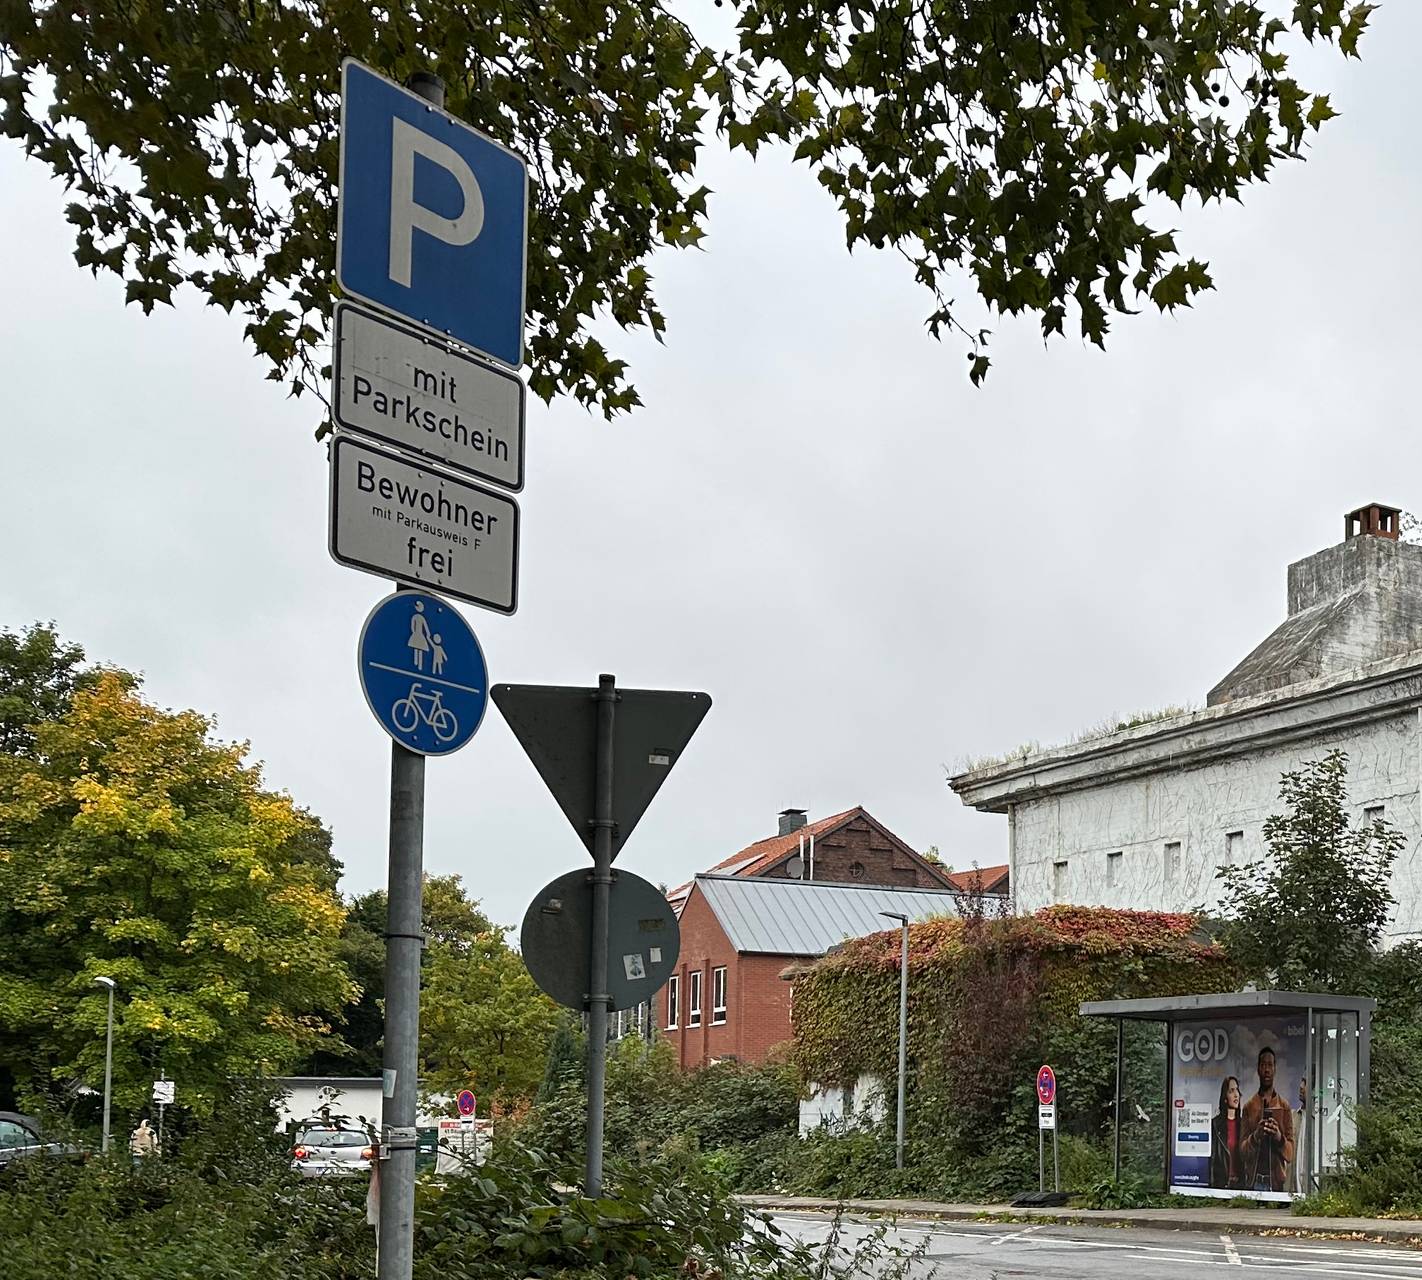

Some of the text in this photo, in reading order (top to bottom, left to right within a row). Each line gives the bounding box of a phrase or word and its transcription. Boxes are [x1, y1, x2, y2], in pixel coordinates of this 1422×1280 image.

[389, 115, 485, 288] P
[413, 367, 457, 403] mit
[353, 374, 508, 462] Parkschein
[357, 461, 498, 535] Bewohner
[372, 505, 481, 550] mit Parkausweis F
[407, 536, 453, 577] frei
[1177, 1028, 1230, 1062] GOD
